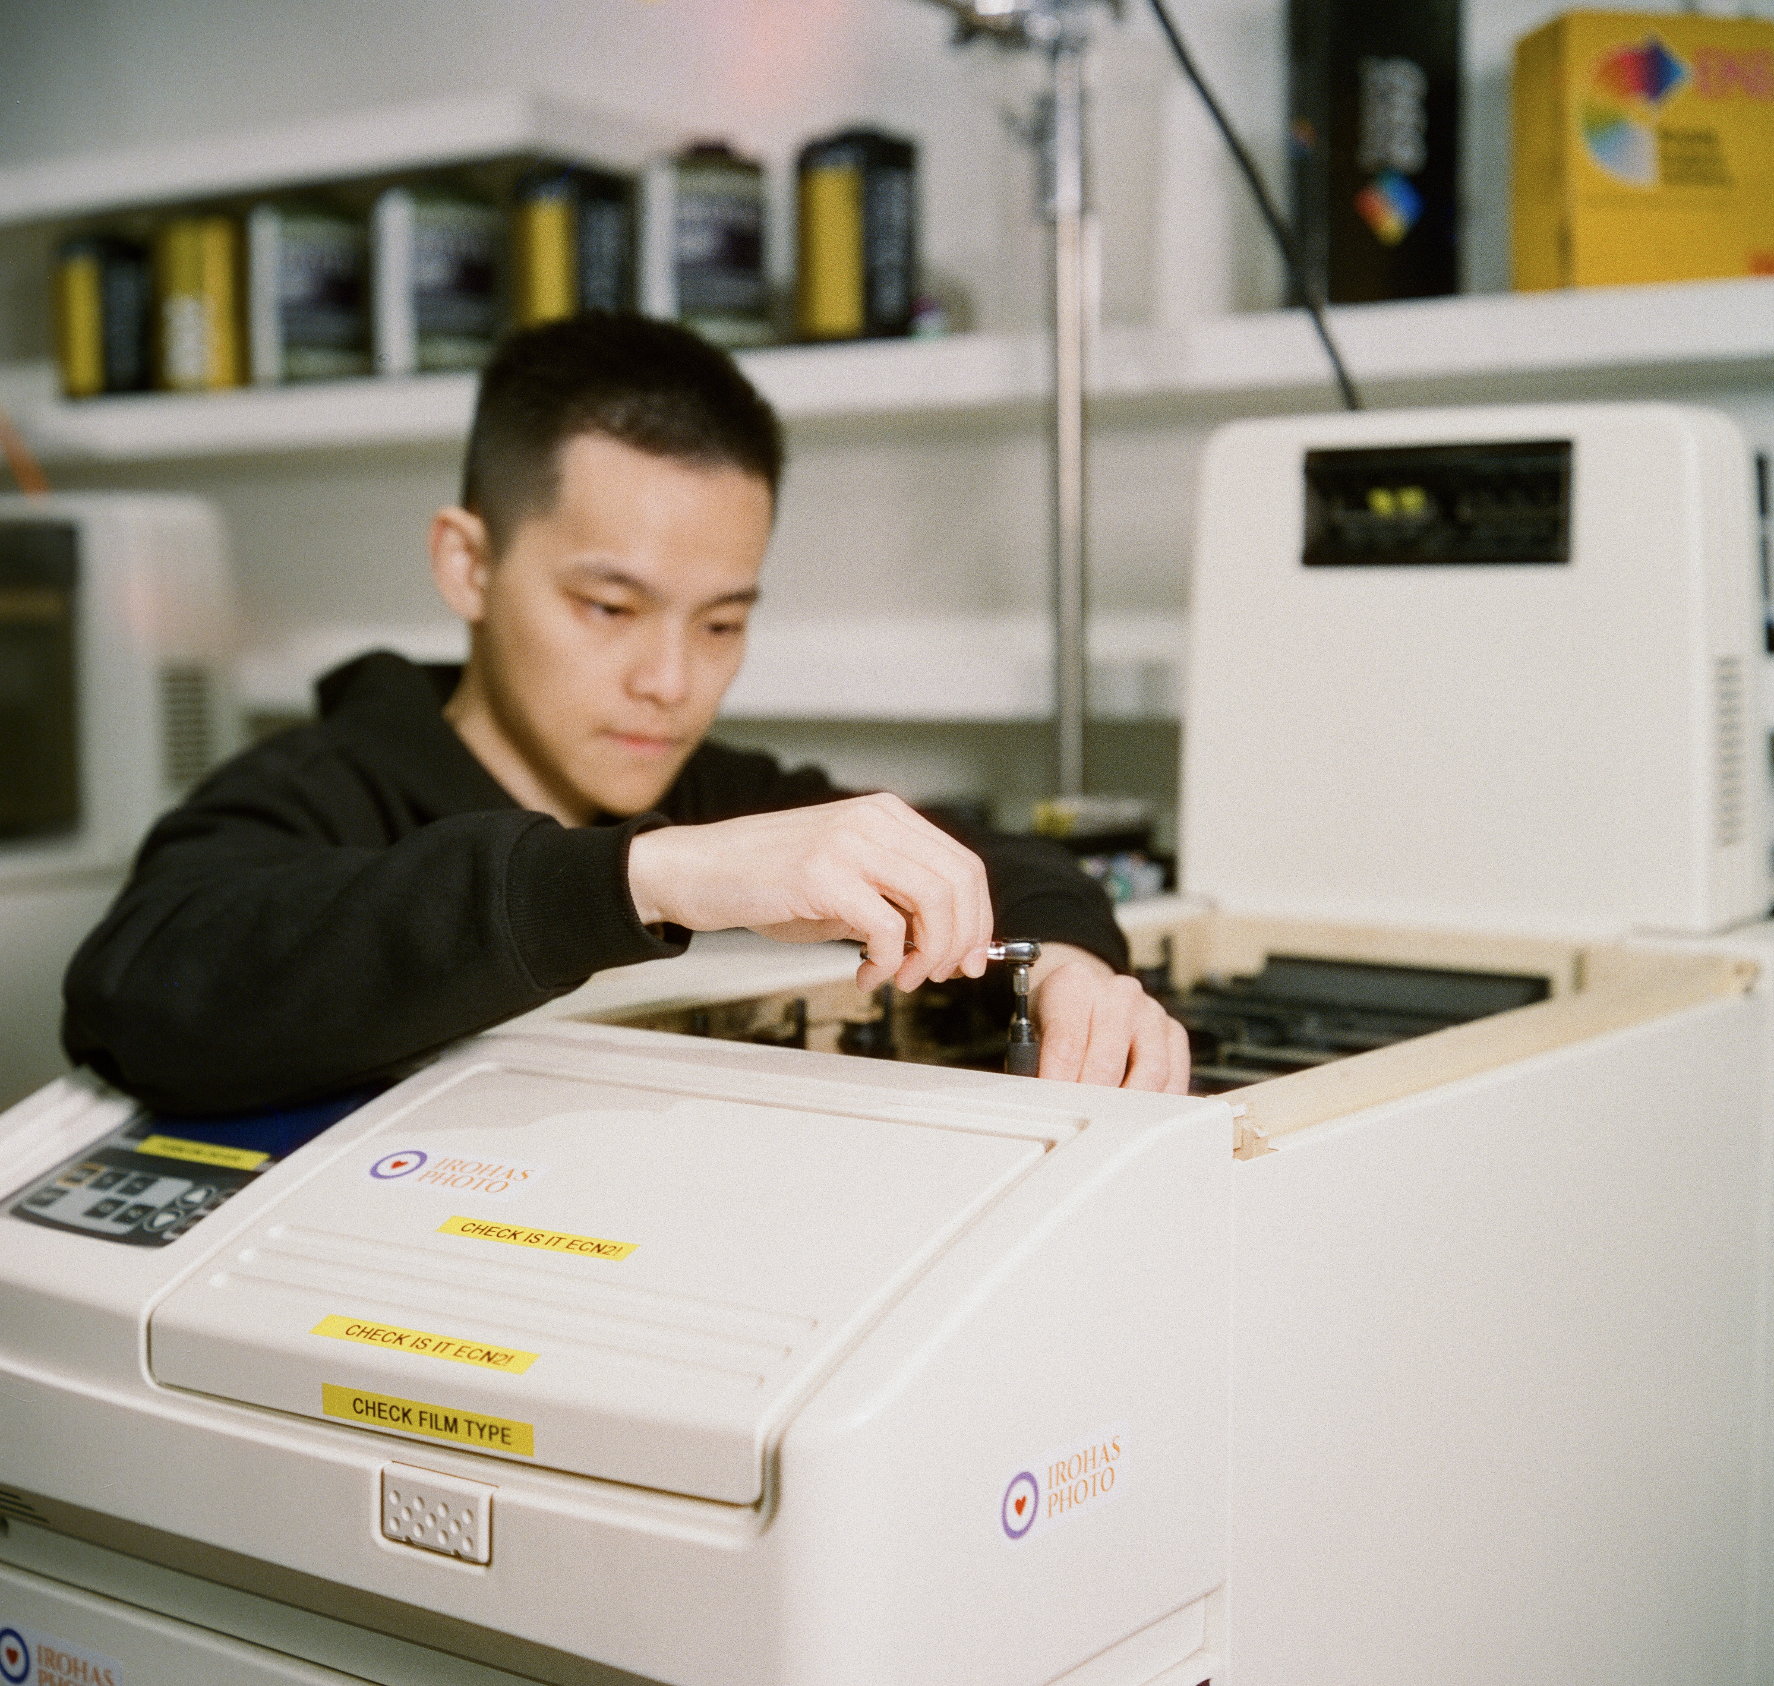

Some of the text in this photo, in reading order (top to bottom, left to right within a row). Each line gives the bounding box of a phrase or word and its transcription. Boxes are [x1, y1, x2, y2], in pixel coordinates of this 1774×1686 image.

[417, 1170, 509, 1194] PHOTO
[434, 1158, 535, 1182] IROHAS
[460, 1222, 623, 1257] CHECK IS IT ECN2!
[345, 1324, 515, 1367] CHECK IS IT ECN2!
[352, 1397, 512, 1446] CHECK FILM TYPE
[1048, 1435, 1121, 1490] IROHAS
[1048, 1466, 1115, 1518] PHOTO
